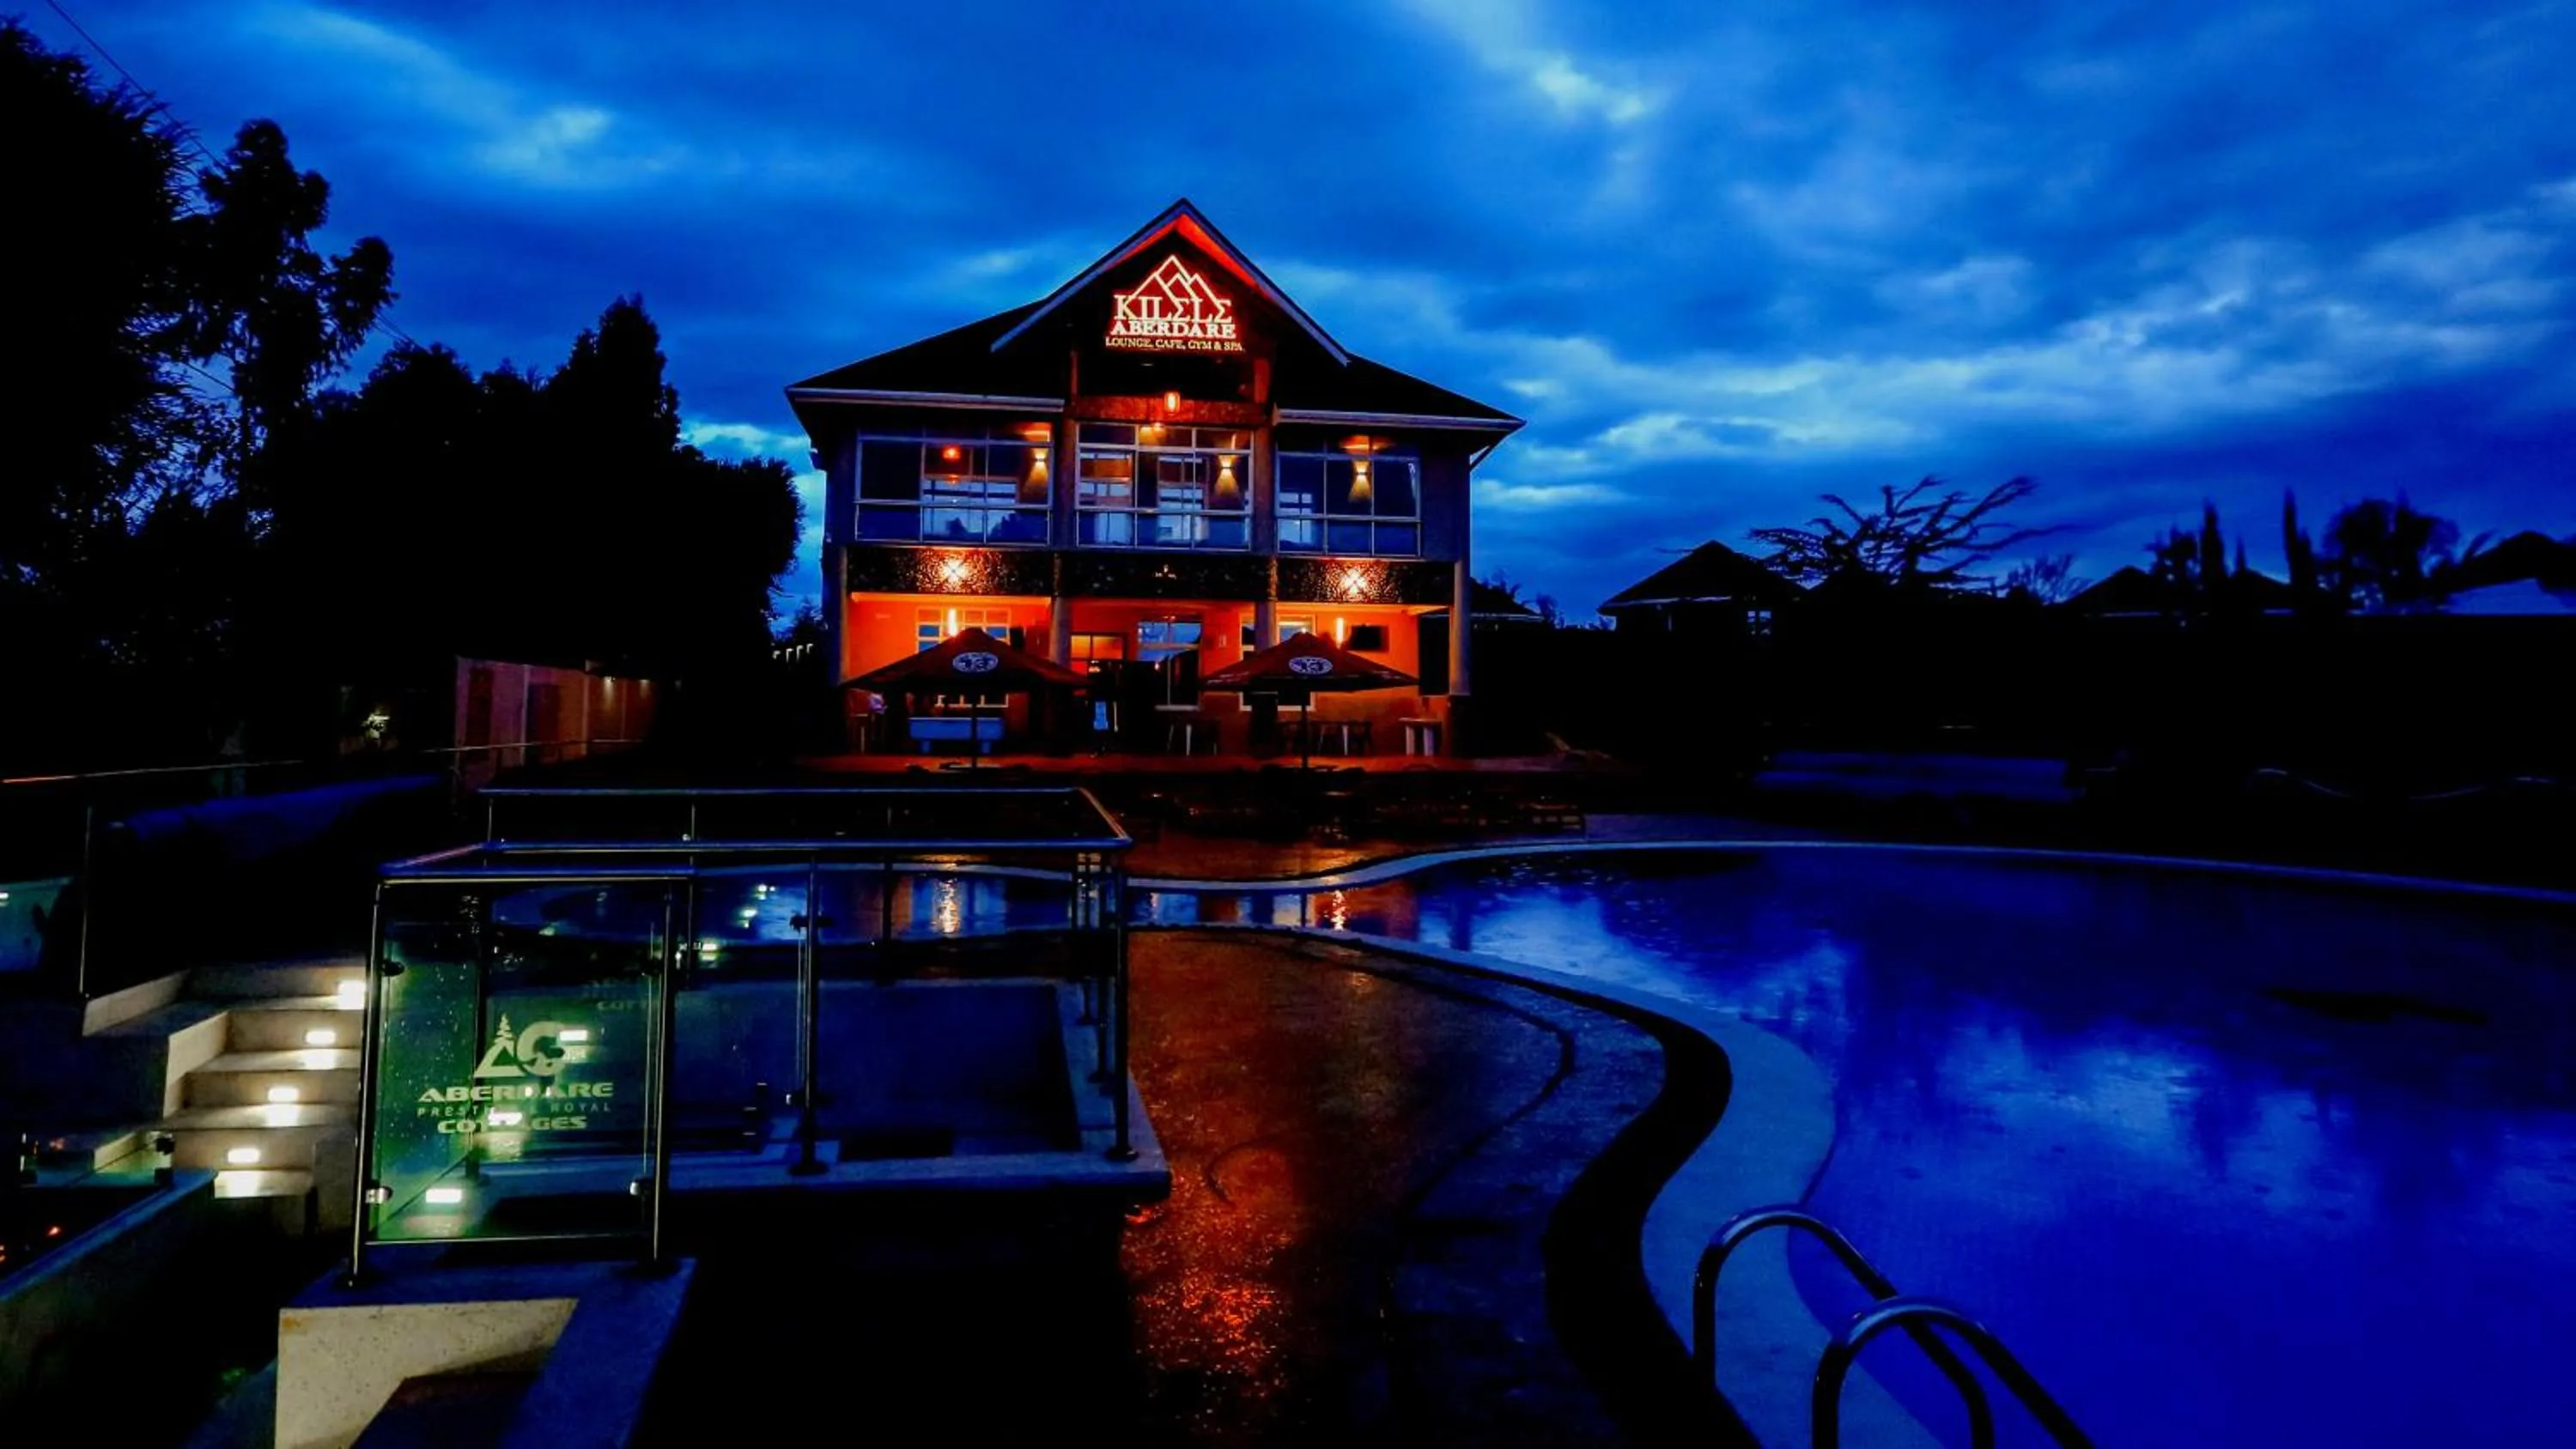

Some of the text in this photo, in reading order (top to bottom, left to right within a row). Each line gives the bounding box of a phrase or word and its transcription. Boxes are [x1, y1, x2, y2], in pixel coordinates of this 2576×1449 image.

[1110, 321, 1236, 339] ABERDARE
[1188, 339, 1212, 350] GYM
[418, 1082, 614, 1103] ABERDARE
[550, 1102, 611, 1113] ROYAL
[437, 1116, 587, 1134] COTGES
